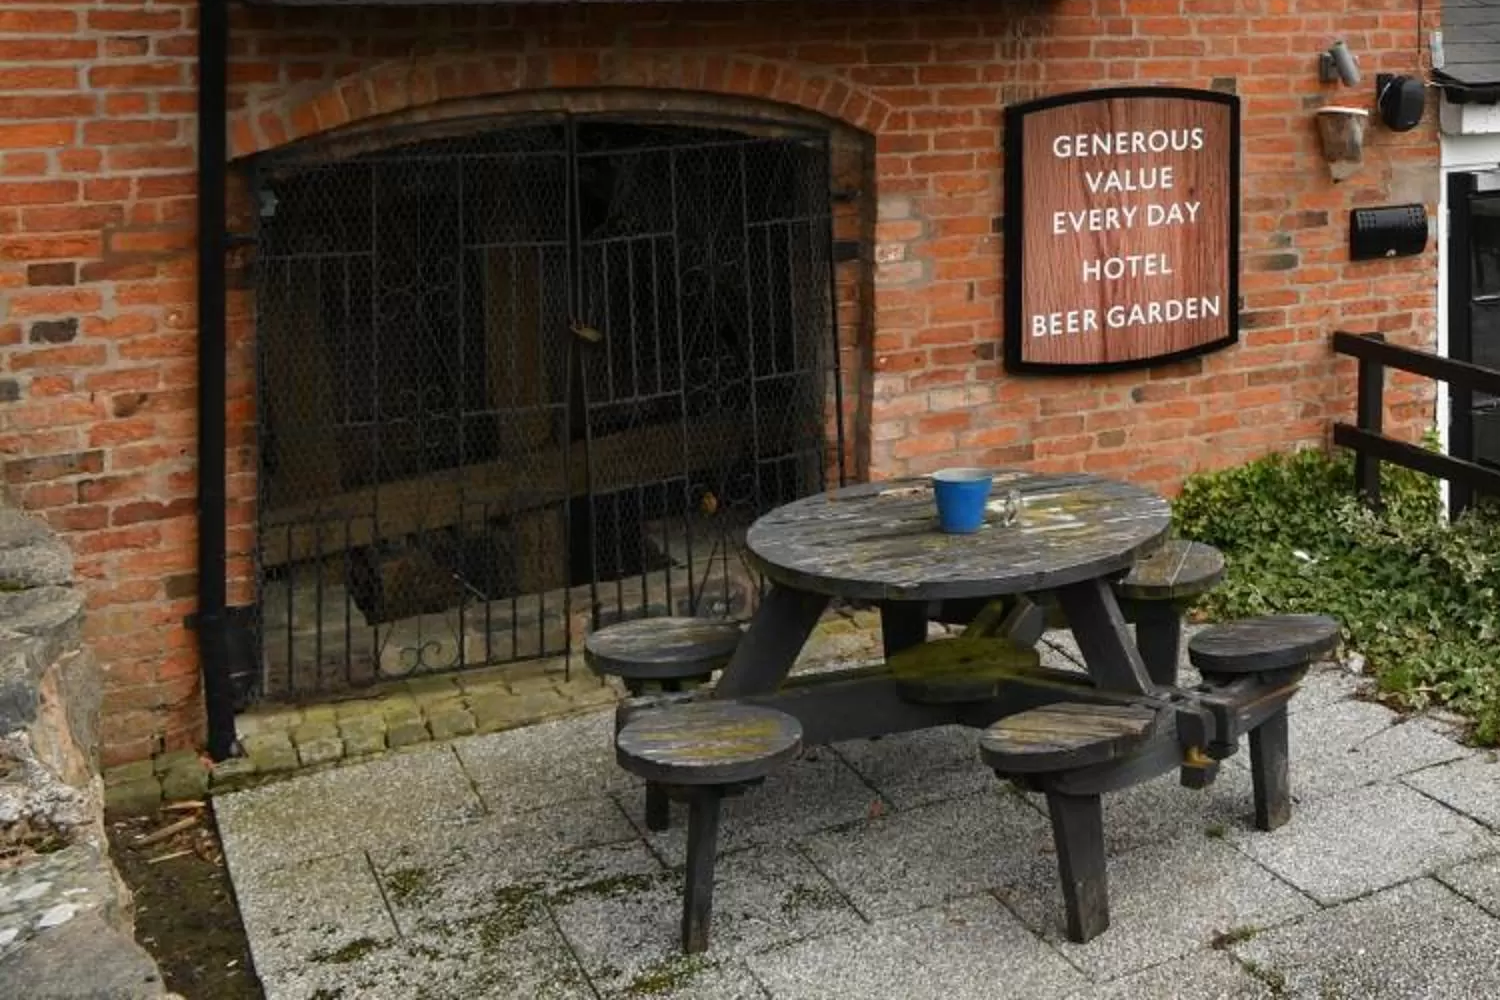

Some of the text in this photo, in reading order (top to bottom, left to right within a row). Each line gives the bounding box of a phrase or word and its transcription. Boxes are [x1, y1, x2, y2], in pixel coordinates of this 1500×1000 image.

[1053, 129, 1203, 157] GENEROUS
[1085, 167, 1173, 193] VALUE
[1053, 202, 1201, 235] EVERY DAY
[1083, 254, 1173, 283] HOTEL
[1032, 295, 1220, 337] BEER GARDEN
